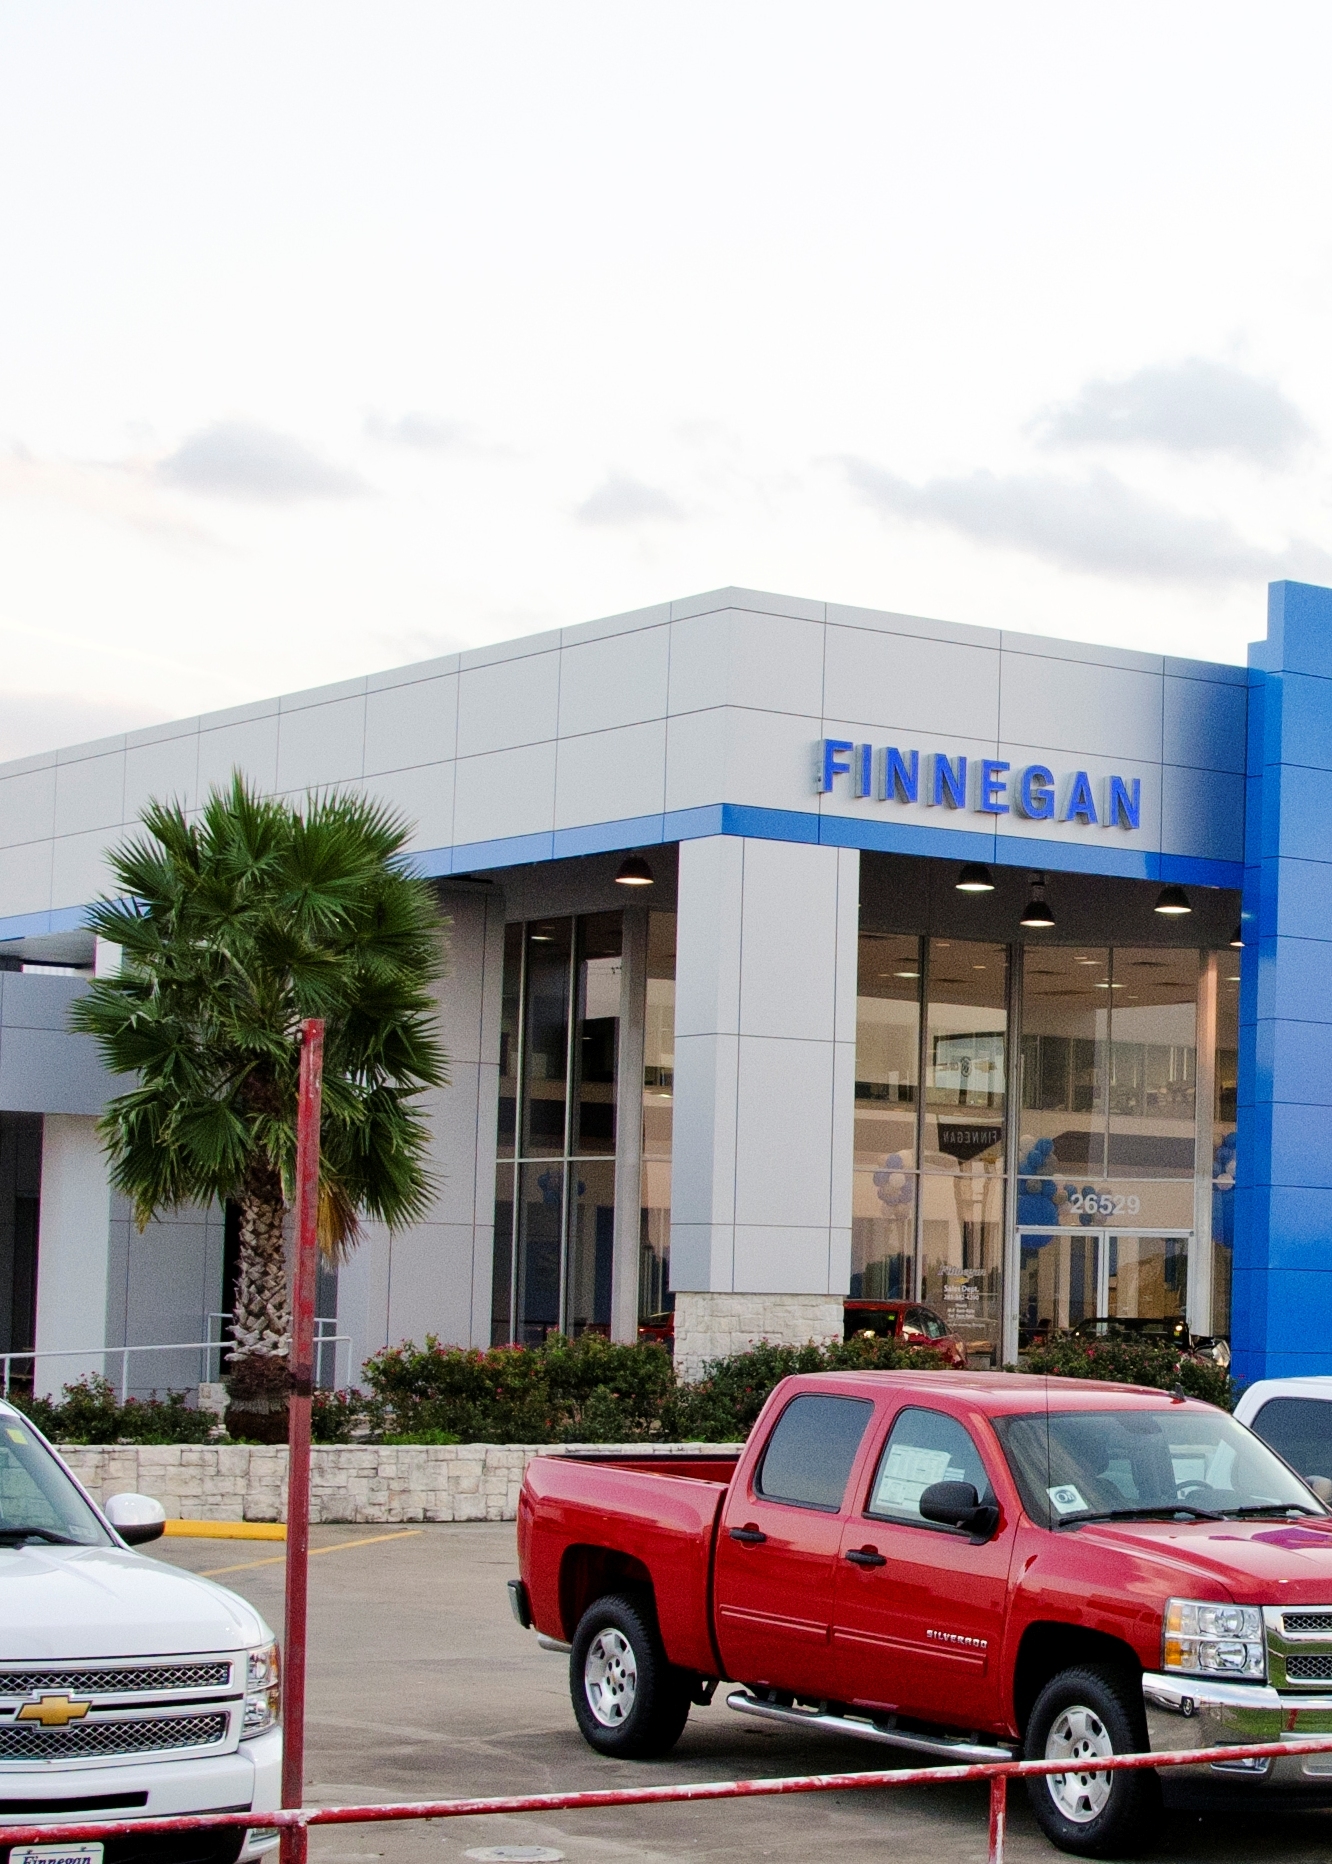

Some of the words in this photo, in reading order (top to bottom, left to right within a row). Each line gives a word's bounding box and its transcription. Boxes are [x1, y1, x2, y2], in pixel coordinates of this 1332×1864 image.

[819, 739, 1141, 829] FINNEGAN
[1070, 1193, 1140, 1215] 26529
[926, 1629, 988, 1648] SILVERADO
